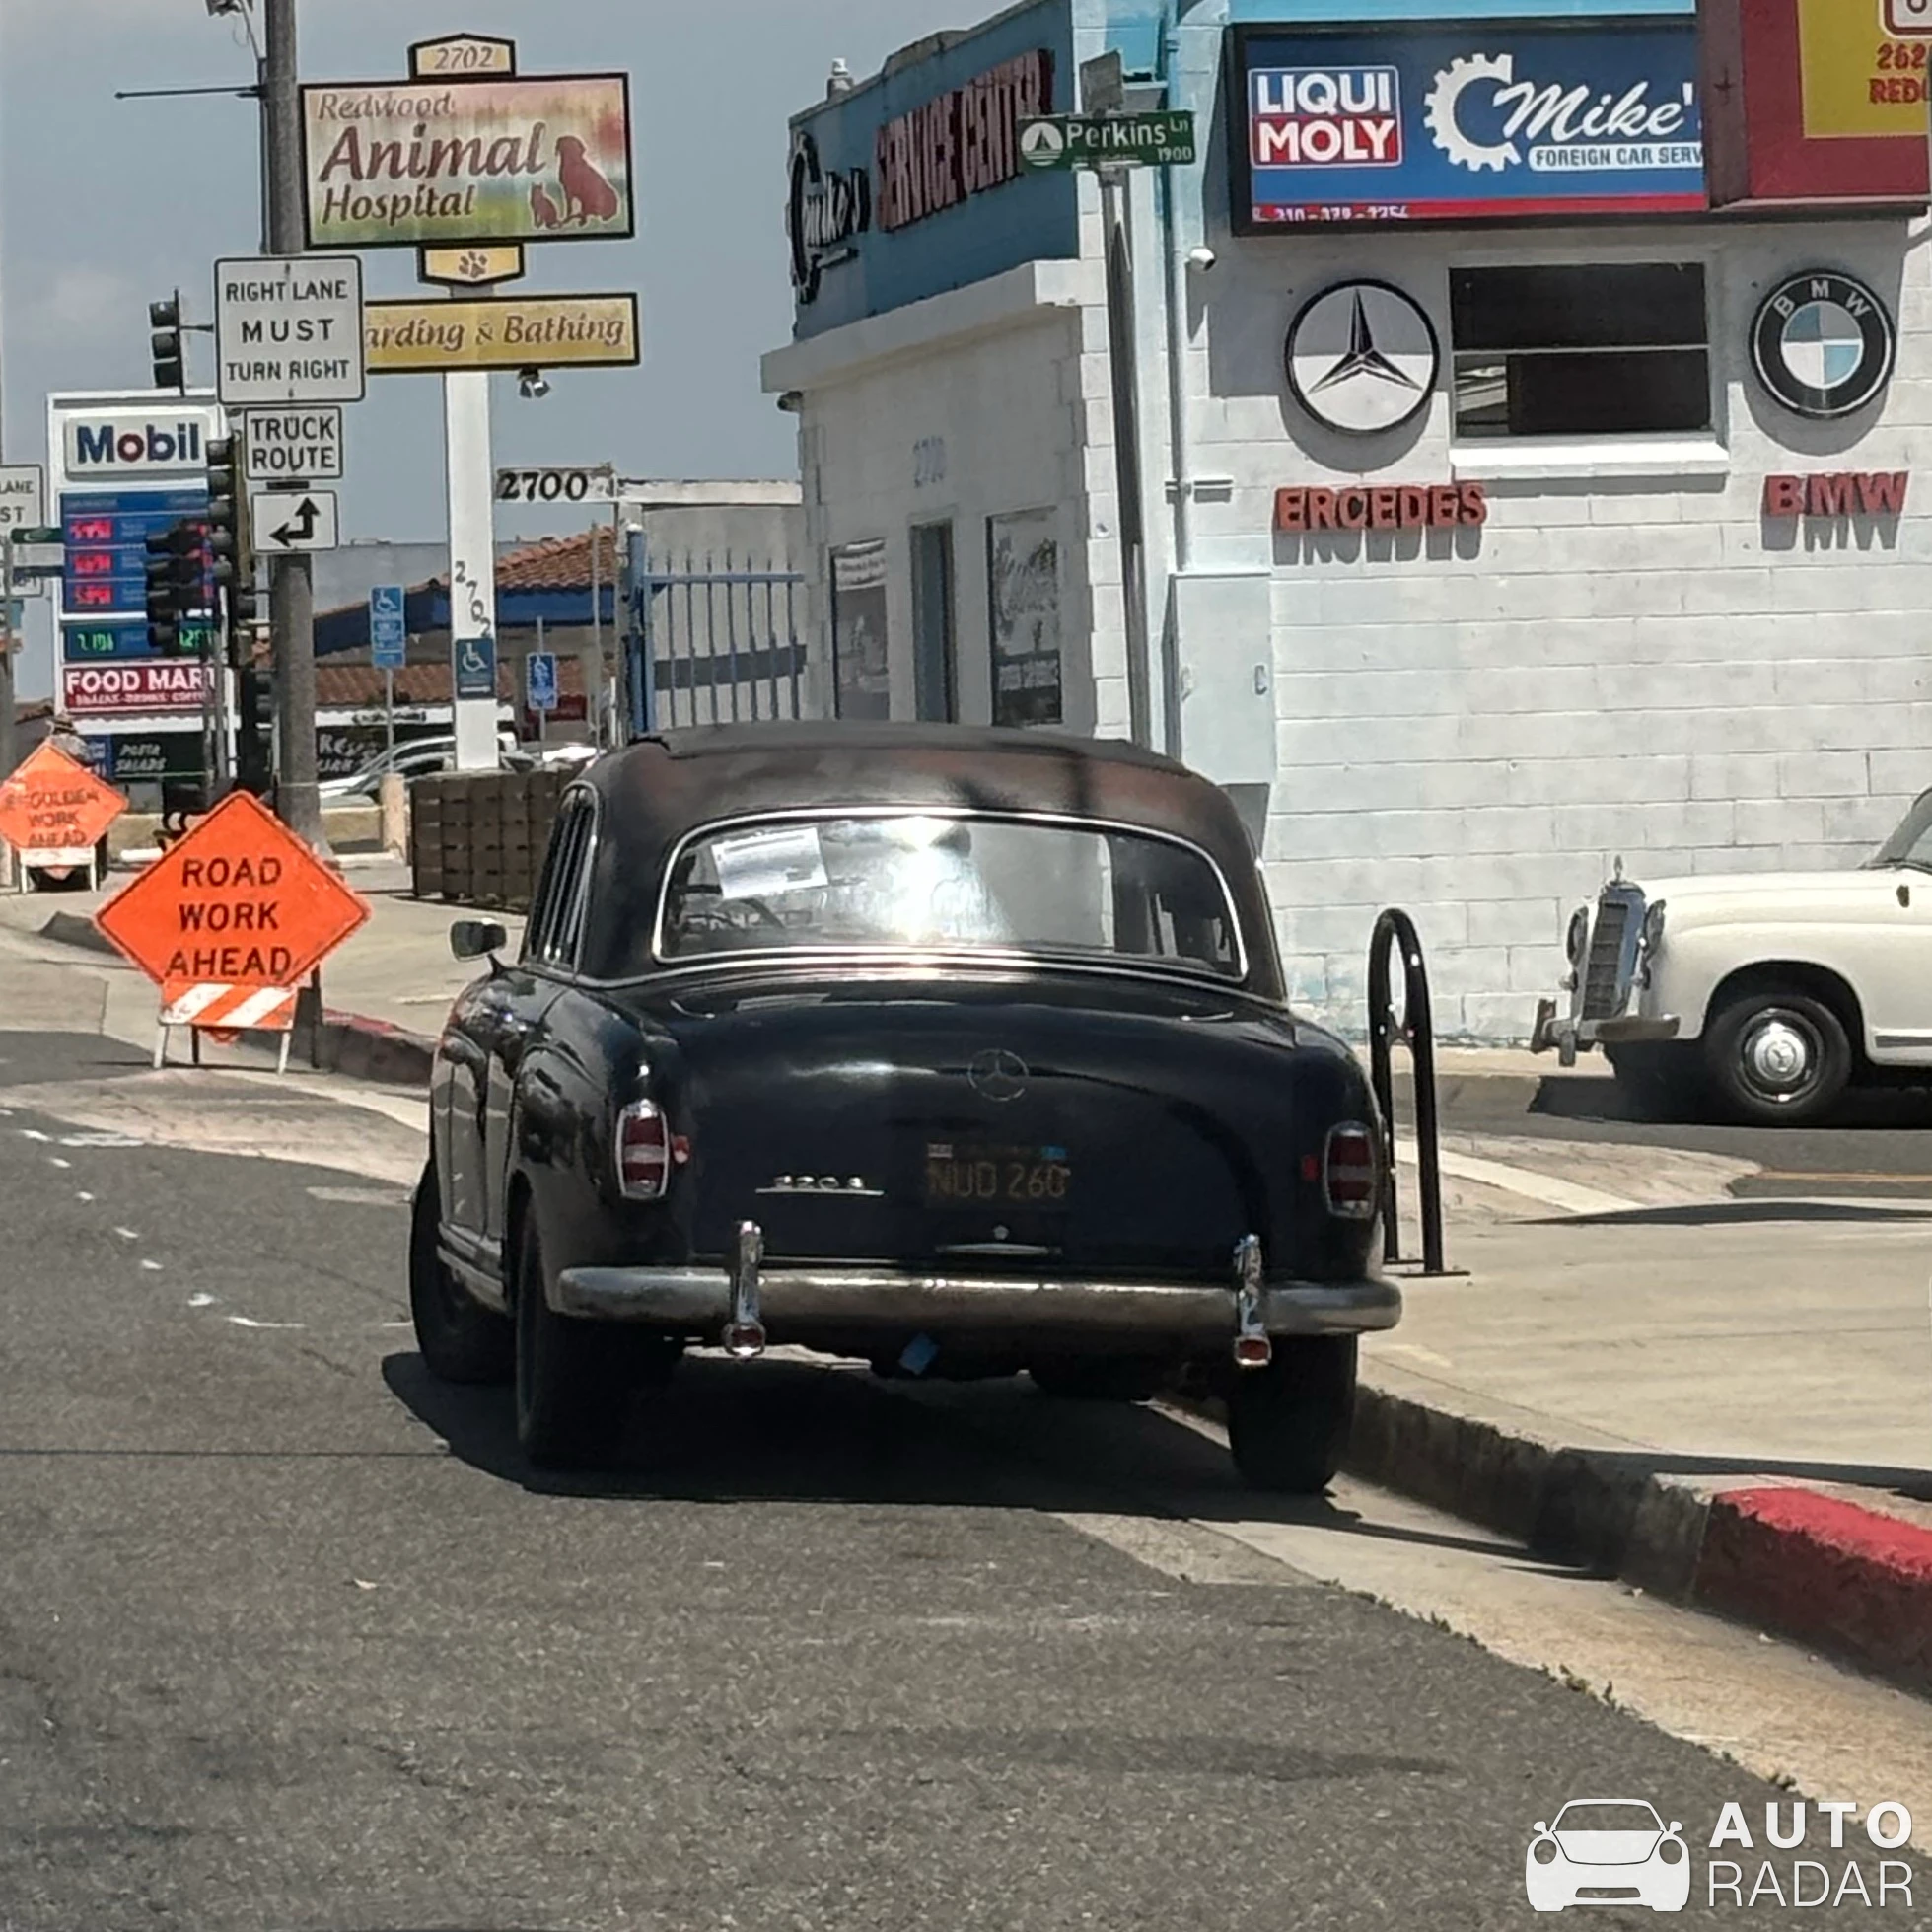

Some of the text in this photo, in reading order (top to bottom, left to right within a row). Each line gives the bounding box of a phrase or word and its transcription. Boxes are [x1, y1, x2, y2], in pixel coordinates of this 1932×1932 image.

[434, 45, 494, 70] 2702
[1877, 43, 1932, 69] 262
[318, 92, 452, 120] Redwood
[1255, 71, 1392, 115] LIQUI
[1870, 77, 1928, 104] RED
[1492, 81, 1702, 143] Mike'
[1066, 117, 1188, 148] Perkins Ln
[1258, 119, 1395, 163] MOLY
[318, 121, 546, 182] Animal
[876, 90, 968, 233] SERVICE
[1158, 147, 1192, 161] 1900
[1536, 148, 1611, 167] FOREIGN
[1617, 147, 1654, 166] CAR
[322, 184, 475, 226] Hospital
[226, 280, 348, 302] RIGHT LANE
[1773, 280, 1872, 319] BMW
[241, 319, 335, 343] MUST
[503, 312, 625, 347] Bathing
[226, 359, 350, 381] TURN RIGHT
[77, 422, 200, 464] Mobil
[250, 416, 335, 441] TRUCK
[252, 446, 335, 470] ROUTE
[497, 470, 590, 501] 2700
[1762, 471, 1909, 517] BMW
[1273, 481, 1487, 530] ERCEDES
[454, 561, 492, 639] 2702
[66, 667, 215, 695] FOOD MART
[29, 811, 81, 827] WORK
[28, 830, 87, 848] AHEAD
[182, 857, 282, 888] ROAD
[179, 901, 279, 932] WORK
[164, 946, 292, 980] AHEAD
